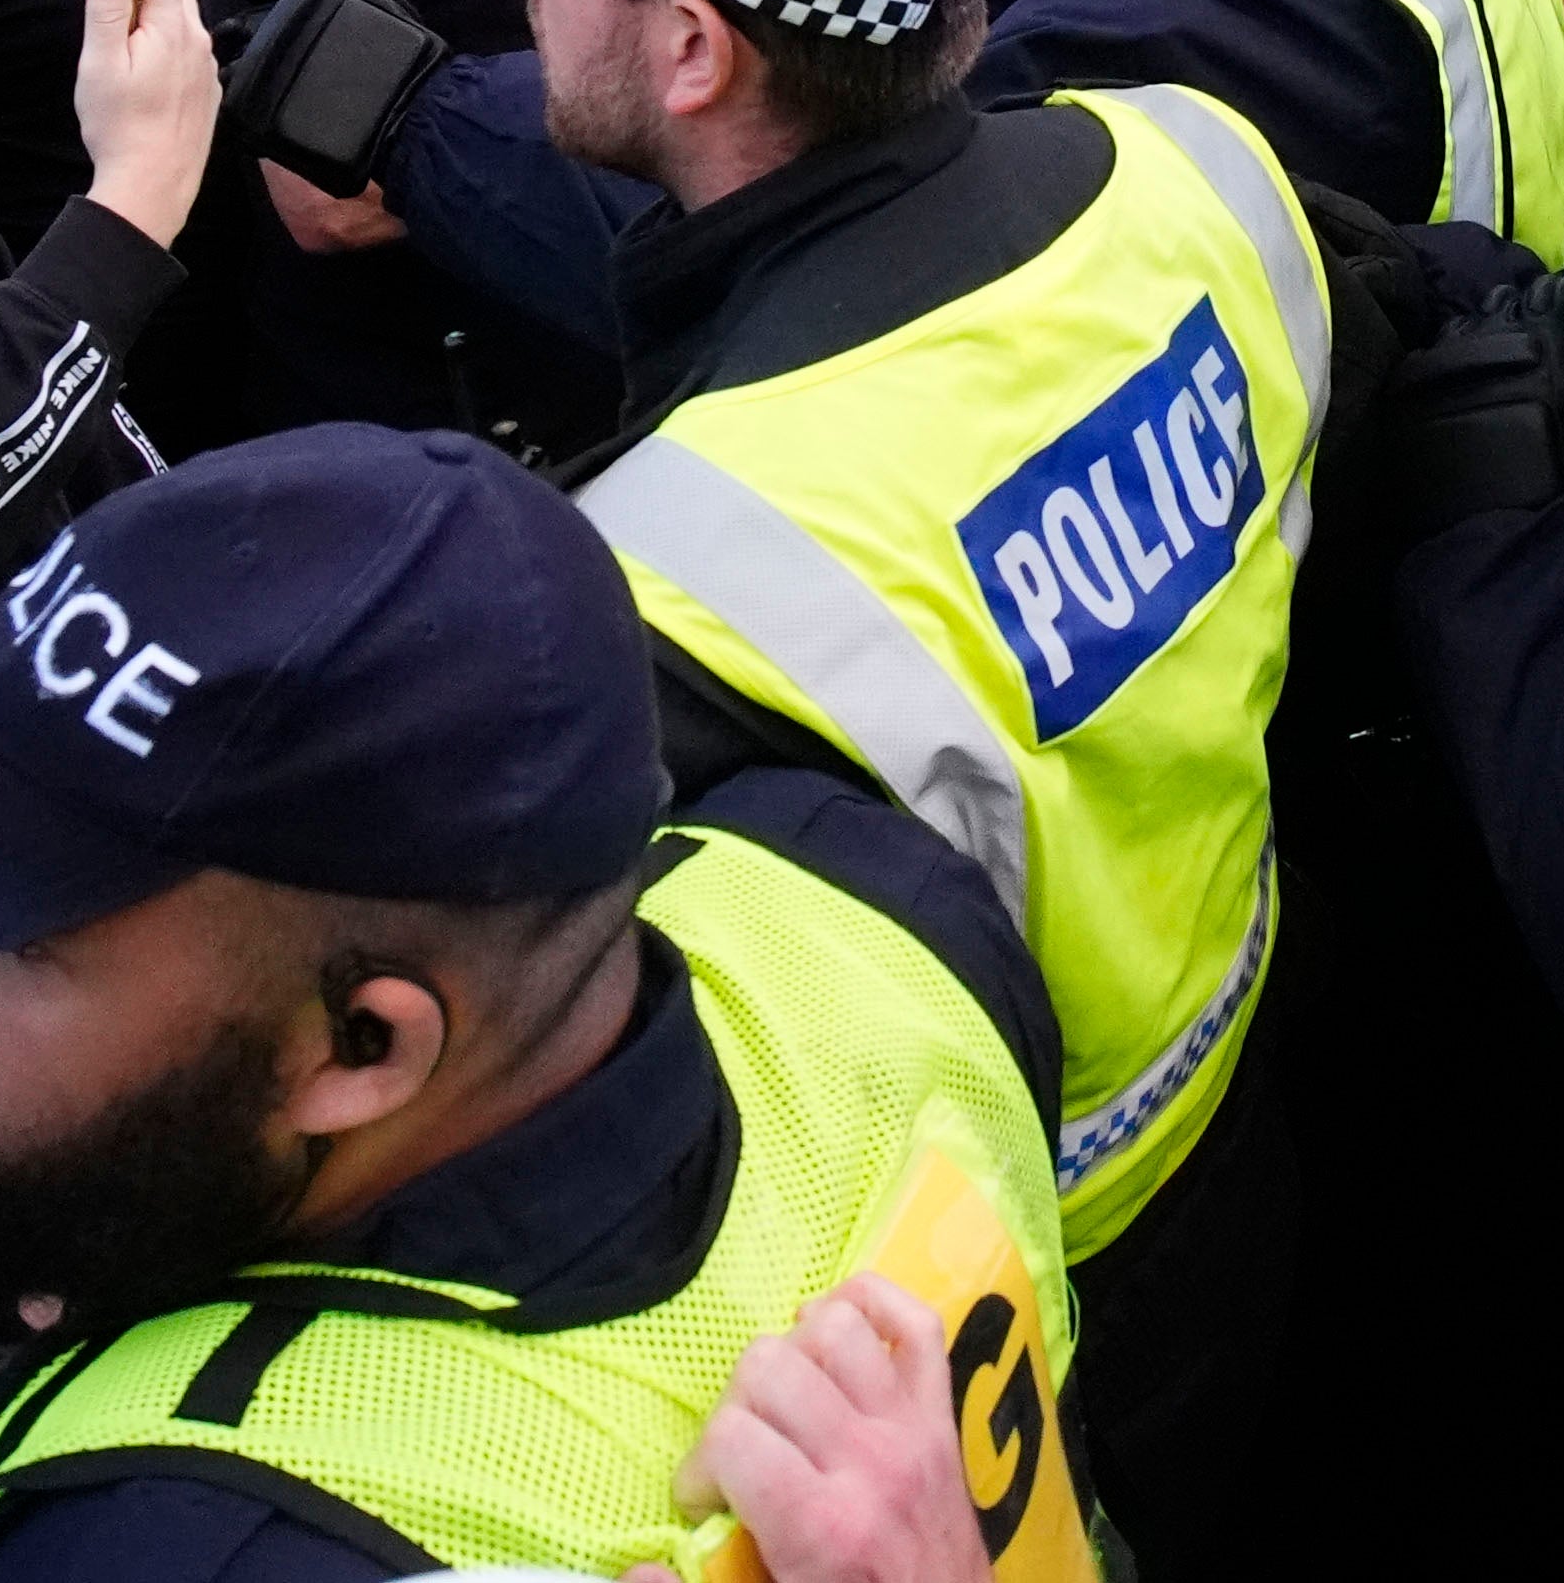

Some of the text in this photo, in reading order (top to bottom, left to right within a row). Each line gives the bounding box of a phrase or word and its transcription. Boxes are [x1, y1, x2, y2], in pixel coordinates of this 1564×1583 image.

[1, 413, 56, 473] NIKE
[50, 346, 103, 410] NIKE
[994, 344, 1249, 689] POLICE
[7, 524, 202, 758] LICE
[947, 1292, 1045, 1567] G
